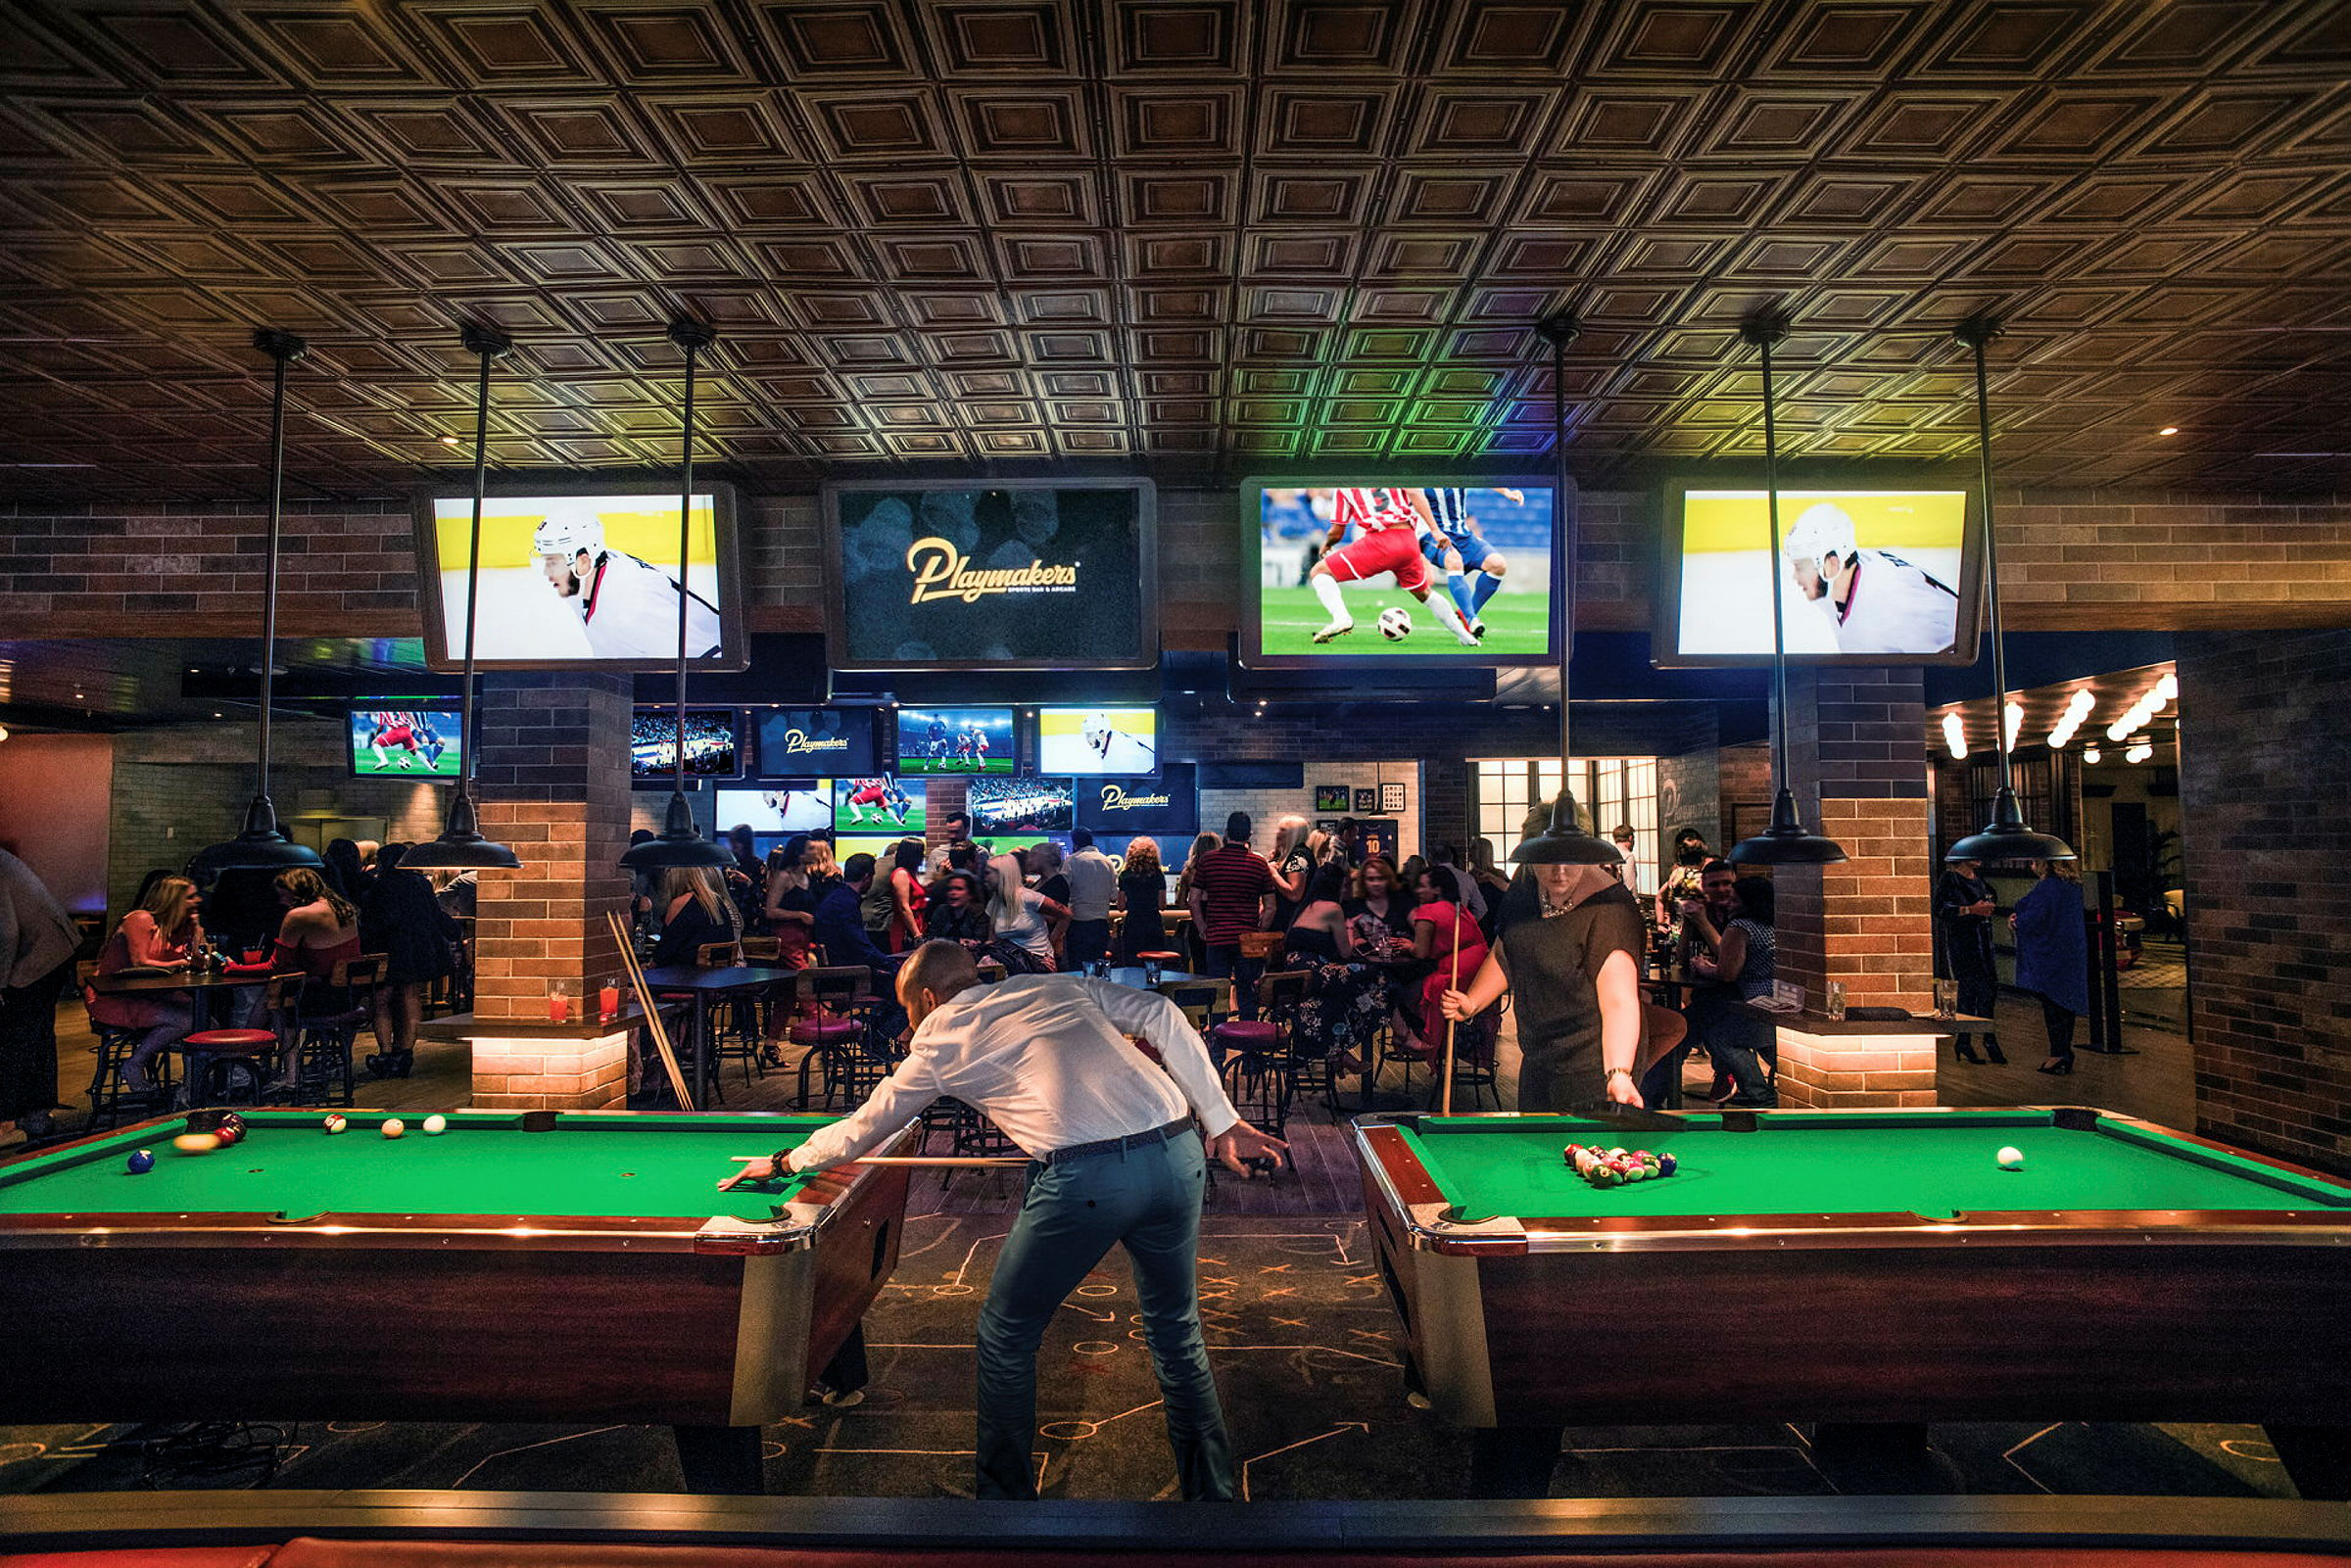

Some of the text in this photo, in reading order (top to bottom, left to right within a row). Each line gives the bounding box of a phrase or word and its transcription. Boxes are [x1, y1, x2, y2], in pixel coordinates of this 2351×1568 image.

[906, 537, 1077, 604] Playmakers
[785, 729, 848, 753] Playmakers
[1101, 784, 1169, 811] Playmakers
[1366, 839, 1379, 853] 10
